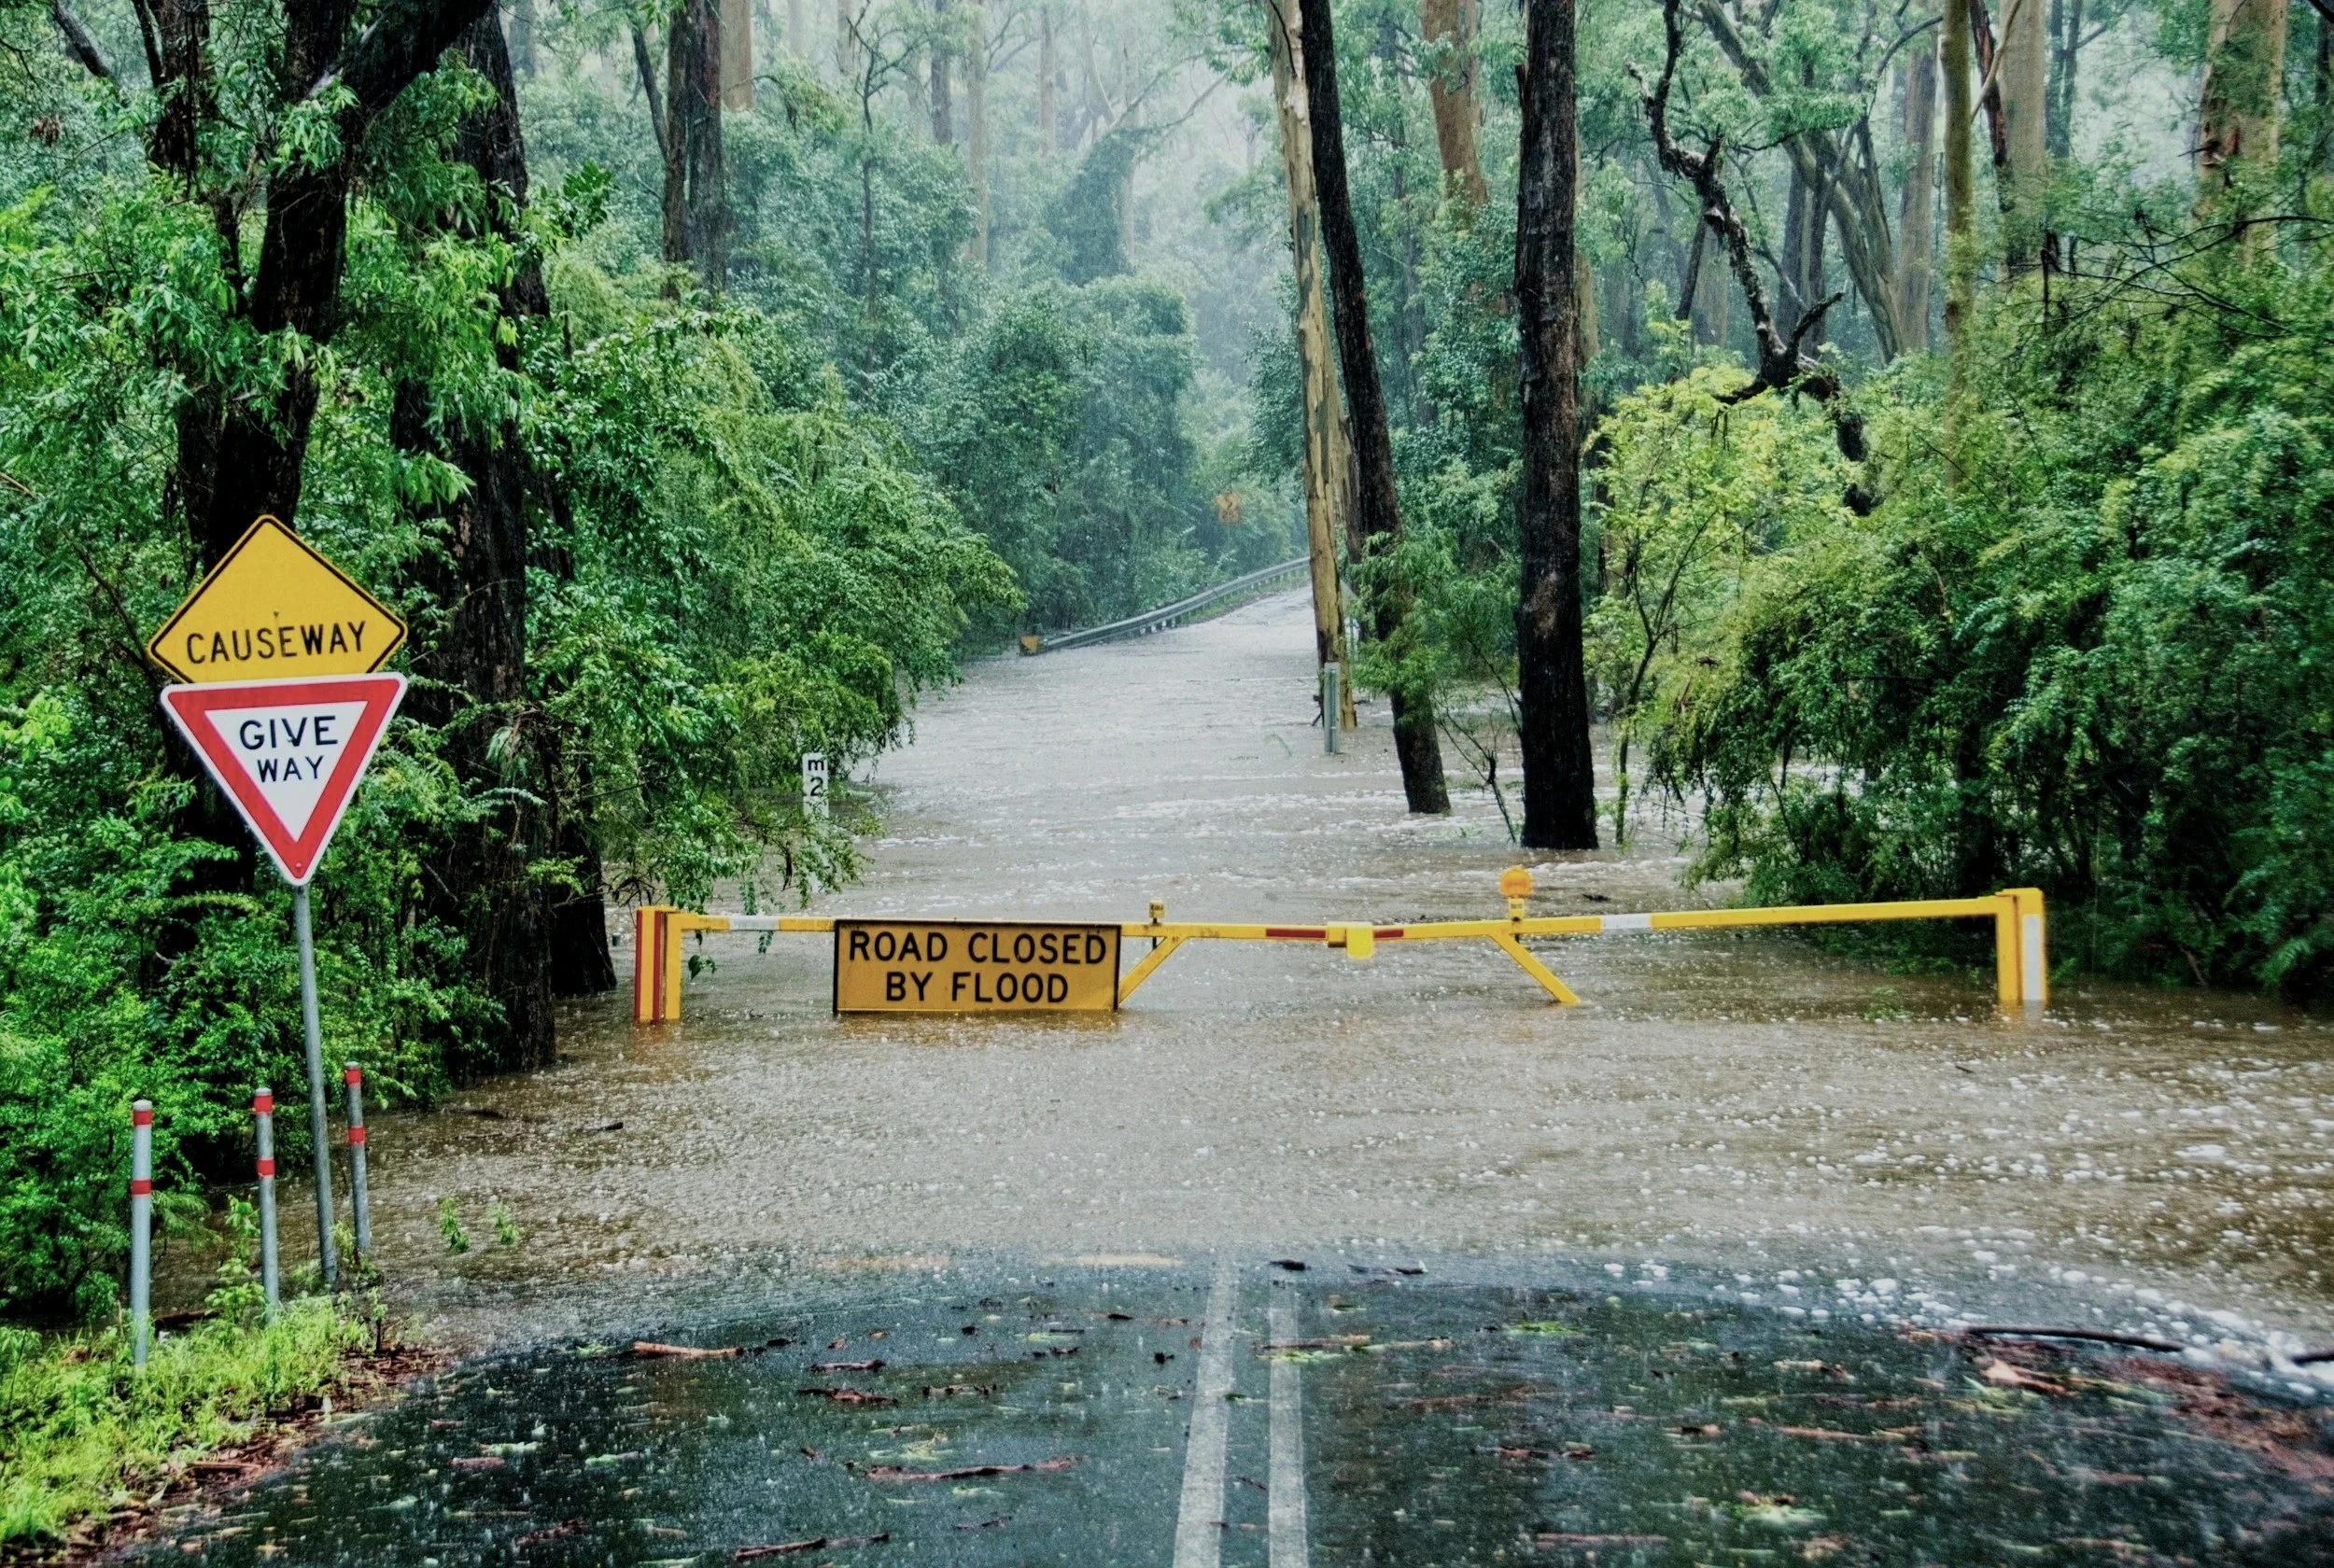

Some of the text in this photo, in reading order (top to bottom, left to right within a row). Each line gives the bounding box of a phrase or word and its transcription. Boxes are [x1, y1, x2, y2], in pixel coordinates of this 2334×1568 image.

[187, 621, 365, 664] CAUSEWAY
[240, 715, 338, 750] GIVE
[258, 755, 324, 783] WAY
[810, 777, 823, 796] 2
[849, 931, 1106, 964] ROAD CLOSED
[886, 972, 1068, 1002] BY FLOOD
